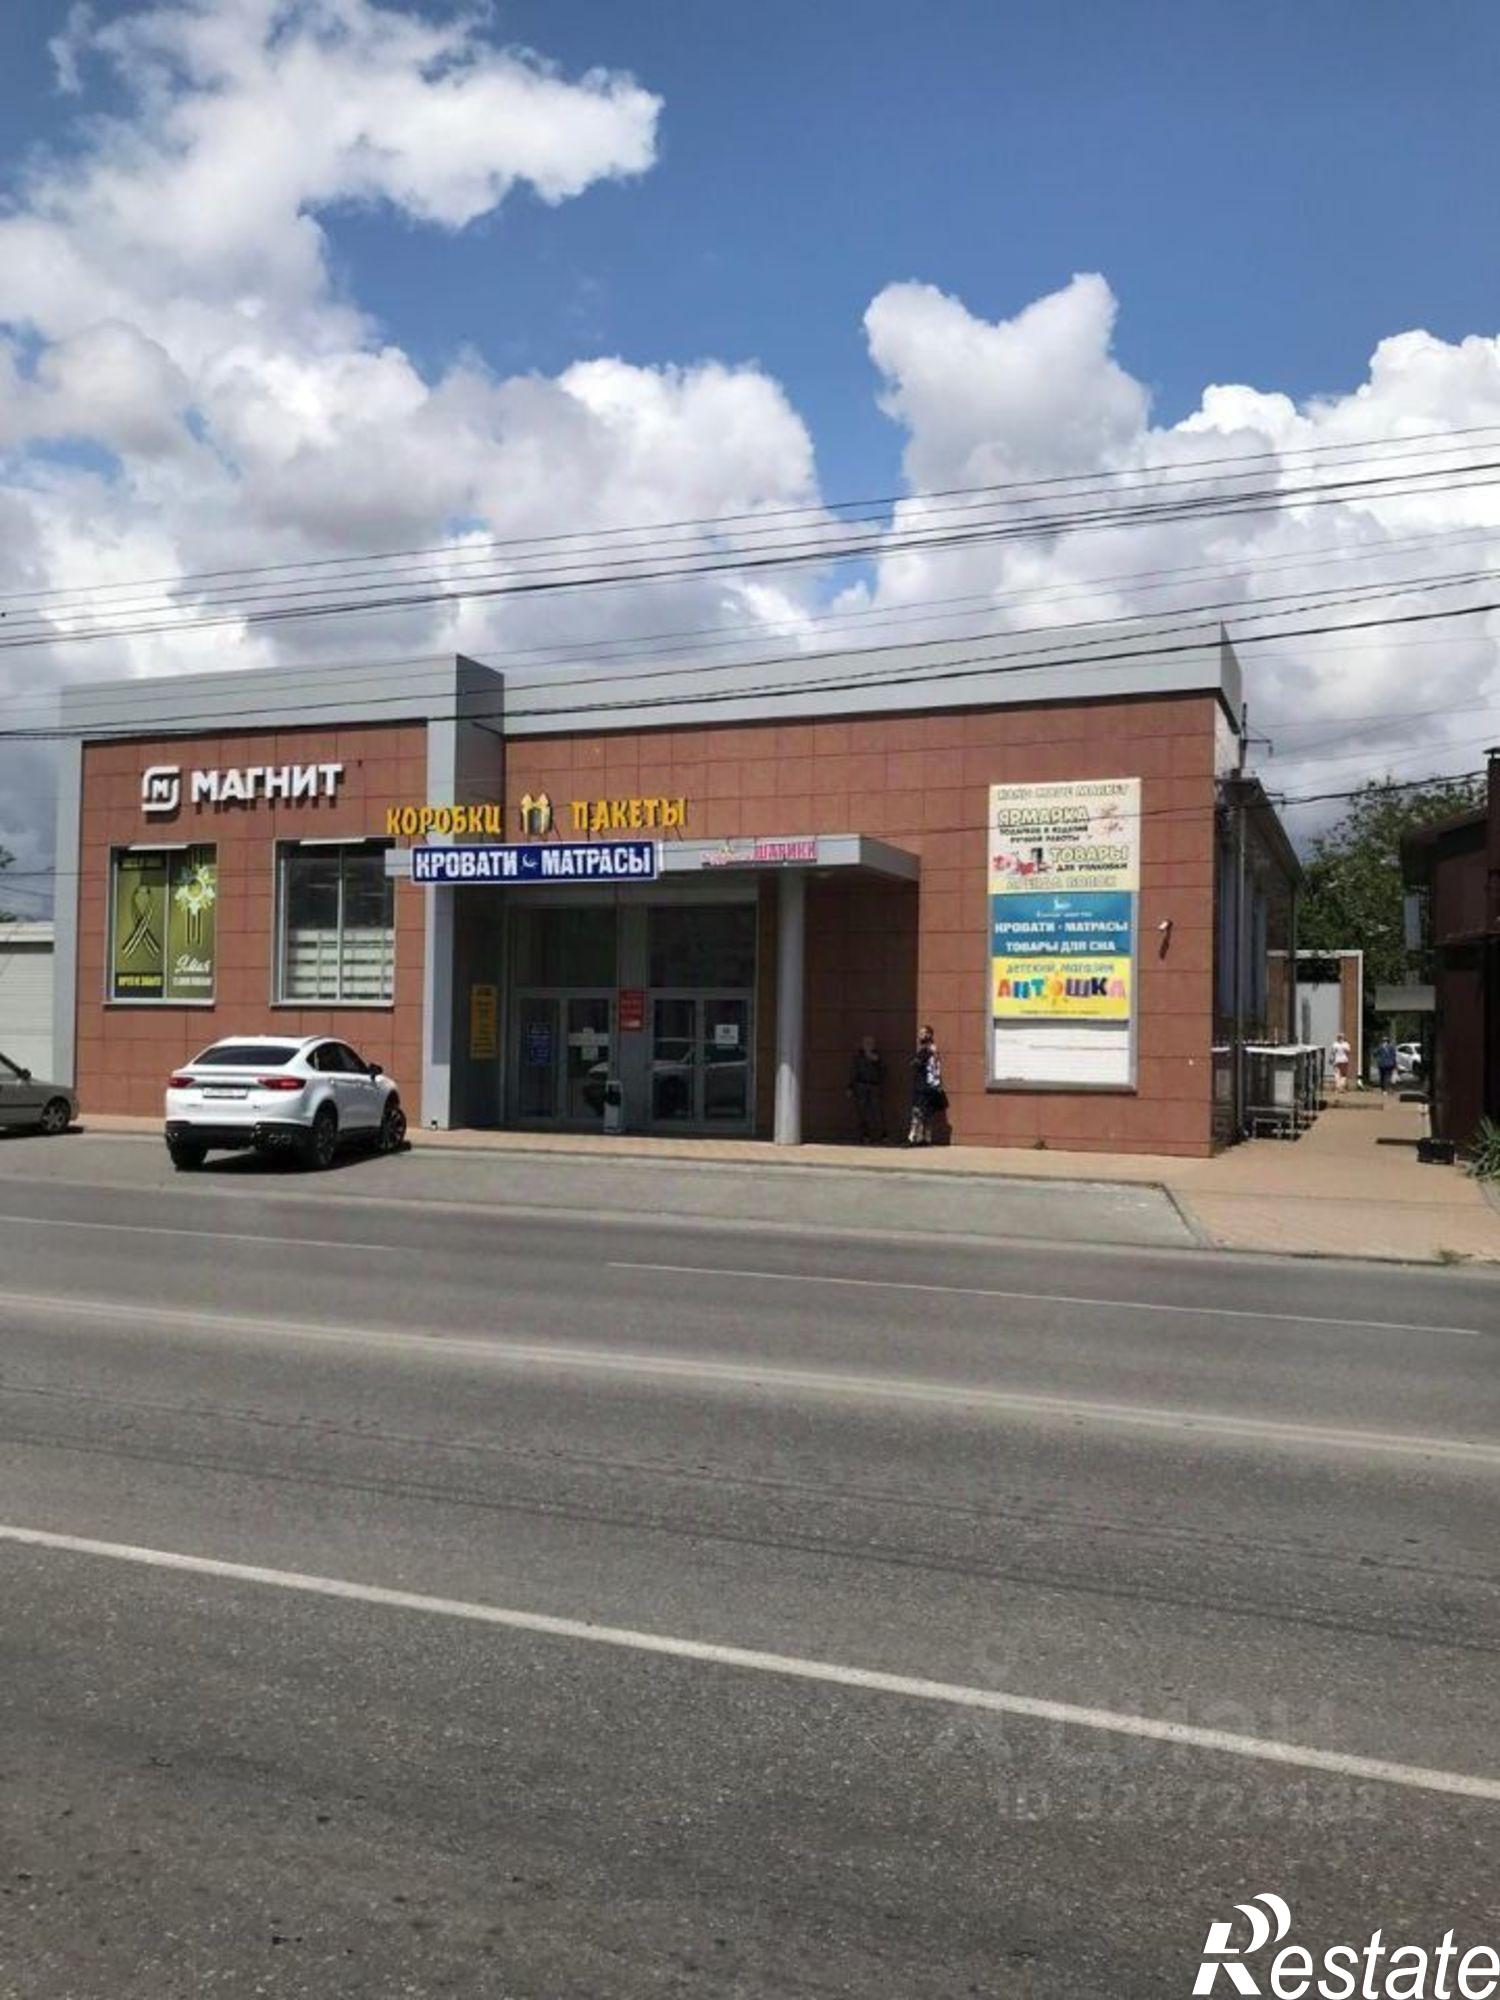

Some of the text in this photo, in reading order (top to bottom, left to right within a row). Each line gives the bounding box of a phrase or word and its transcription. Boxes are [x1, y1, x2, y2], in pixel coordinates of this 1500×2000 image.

[191, 764, 343, 803] МАГНИТ
[386, 798, 686, 835] КОРОБКИ ПАКЕТЫ
[997, 805, 1090, 828] ЯРМАРКА
[416, 847, 651, 878] КРОВАТИ МАТРАСЫ
[1050, 845, 1130, 863] ТОВАРЫ
[995, 919, 1129, 934] КРОВАТИ МАТРАСЫ
[1006, 940, 1116, 954] ТОВАРЫ ДЛЯ СНА
[997, 976, 1127, 999] АНТОШКА
